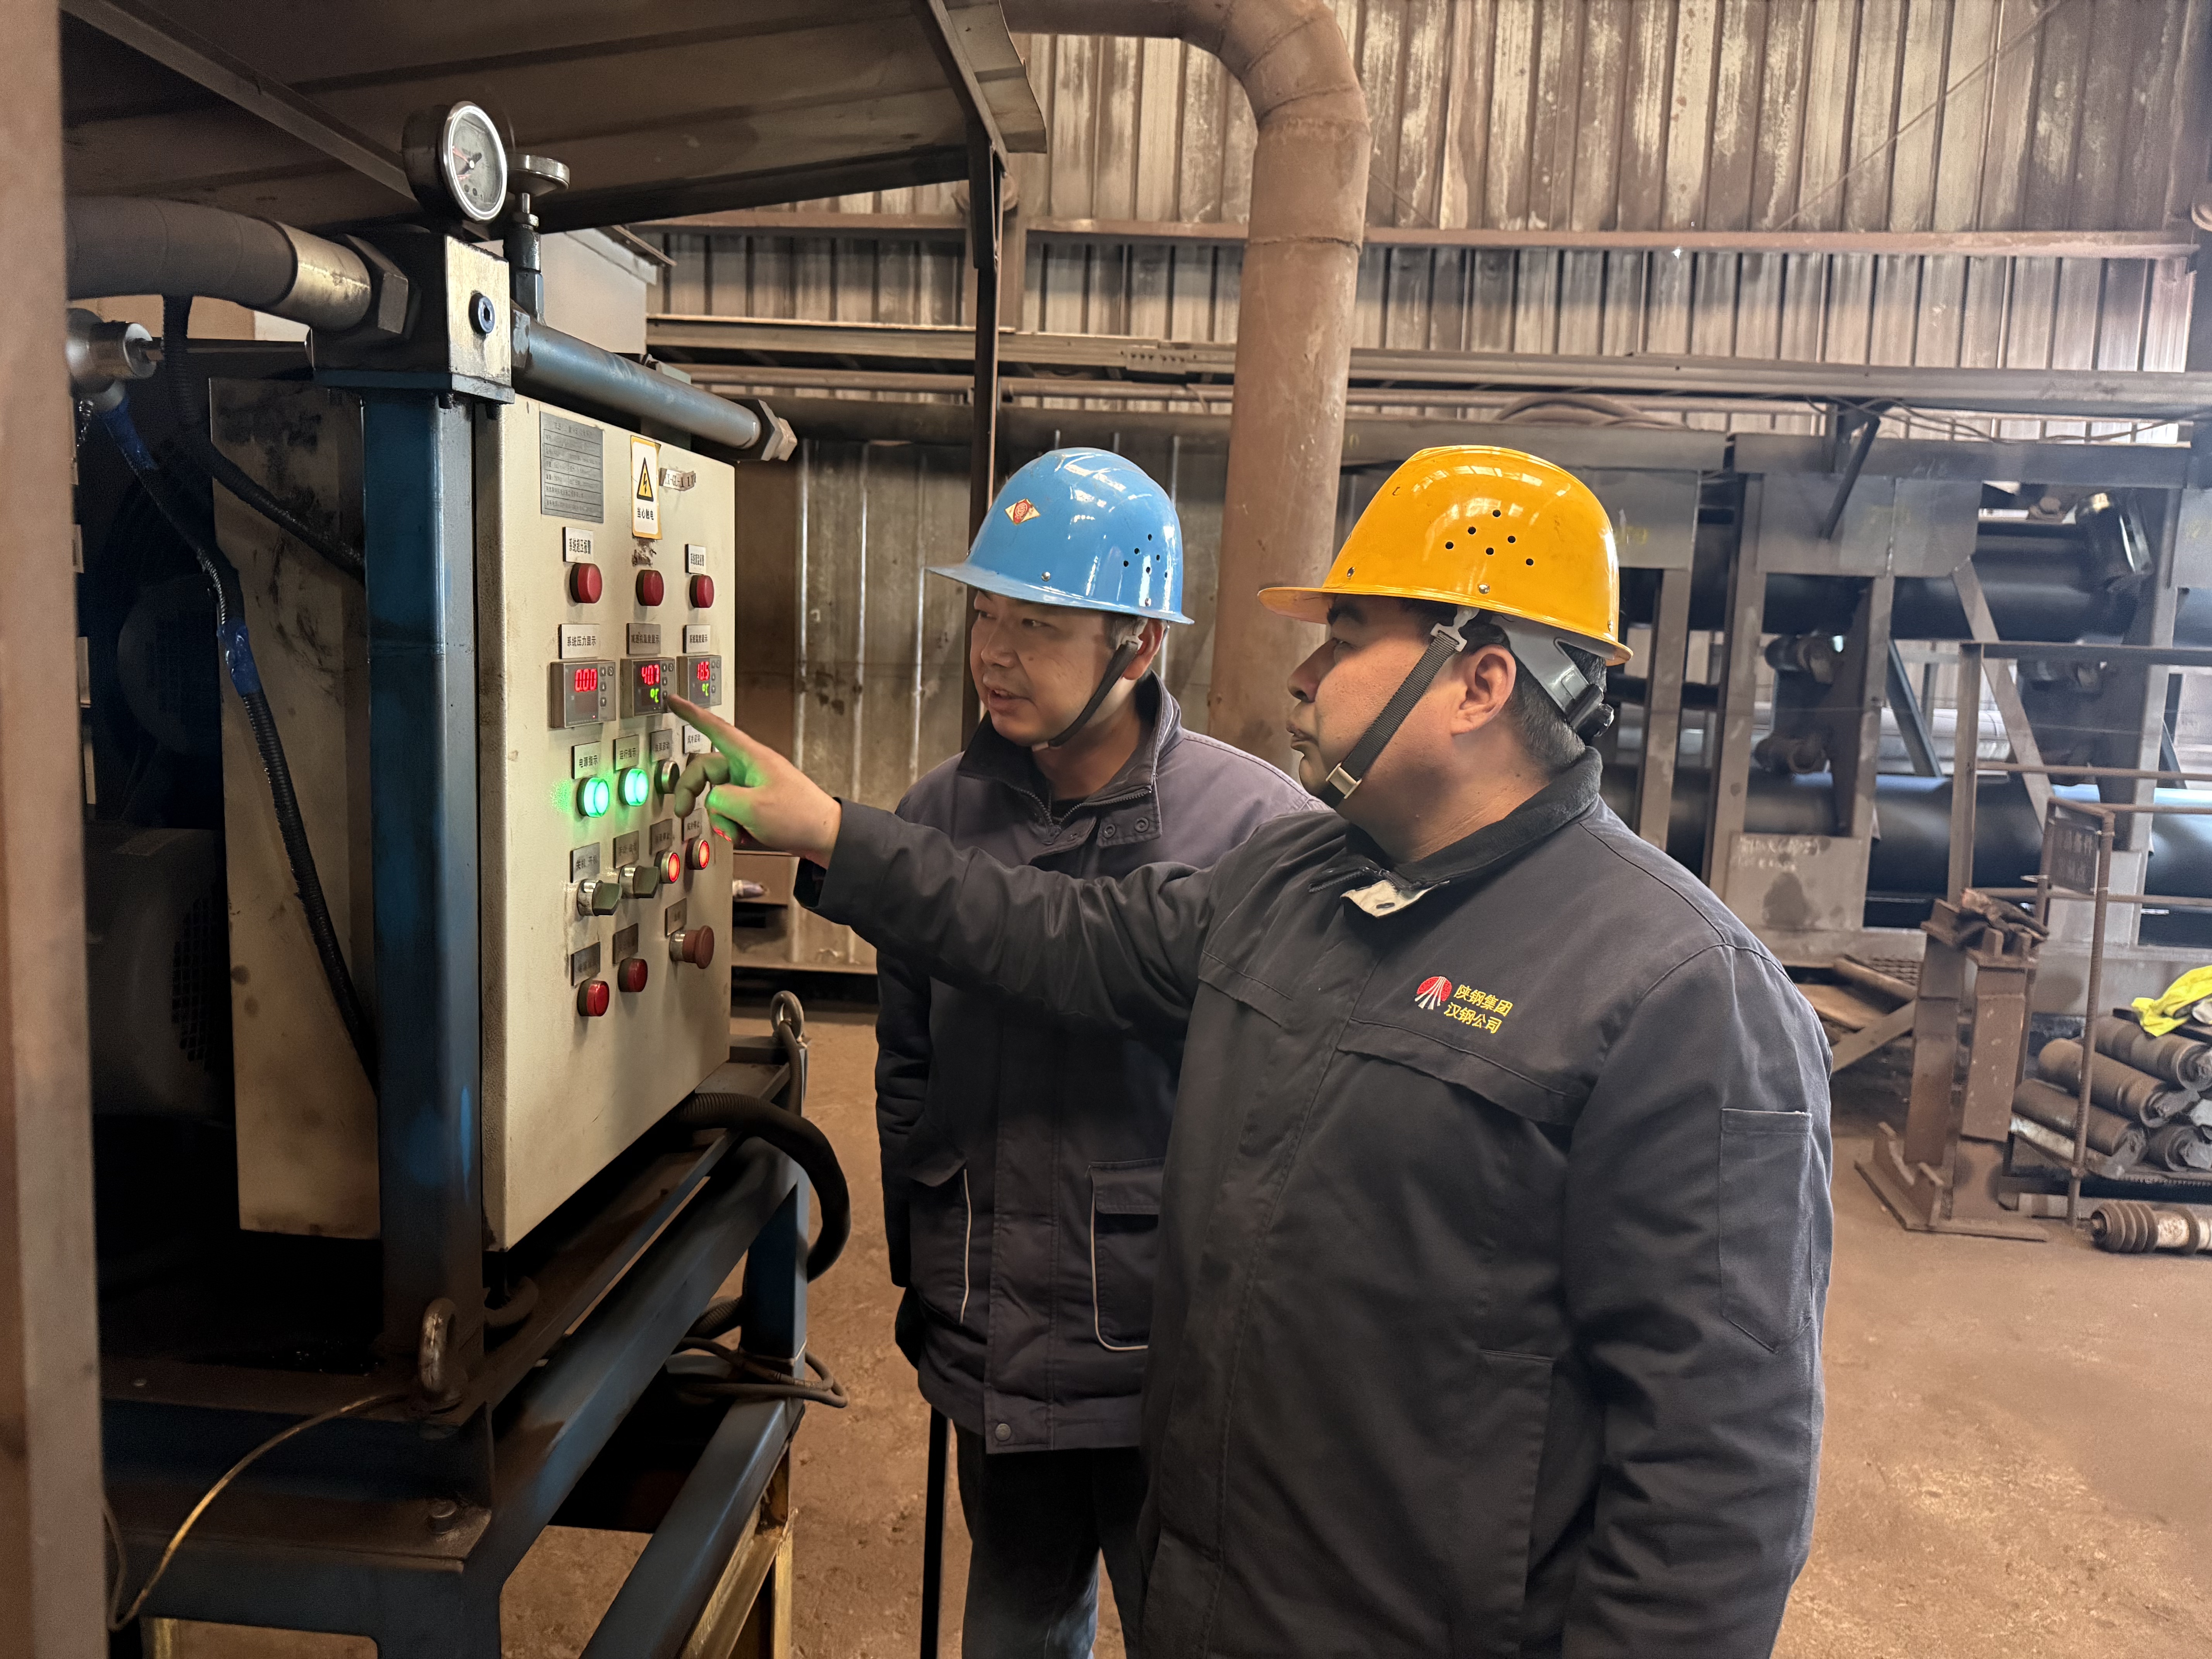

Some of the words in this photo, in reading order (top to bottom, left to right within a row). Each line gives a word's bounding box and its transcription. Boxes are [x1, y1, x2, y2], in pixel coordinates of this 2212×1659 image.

[637, 507, 654, 520] 当心触电
[567, 635, 596, 646] 系统压力显示
[579, 754, 598, 768] 电源指示
[1453, 984, 1513, 1017] 陕钢集团
[1443, 1002, 1502, 1034] 汉钢公司
